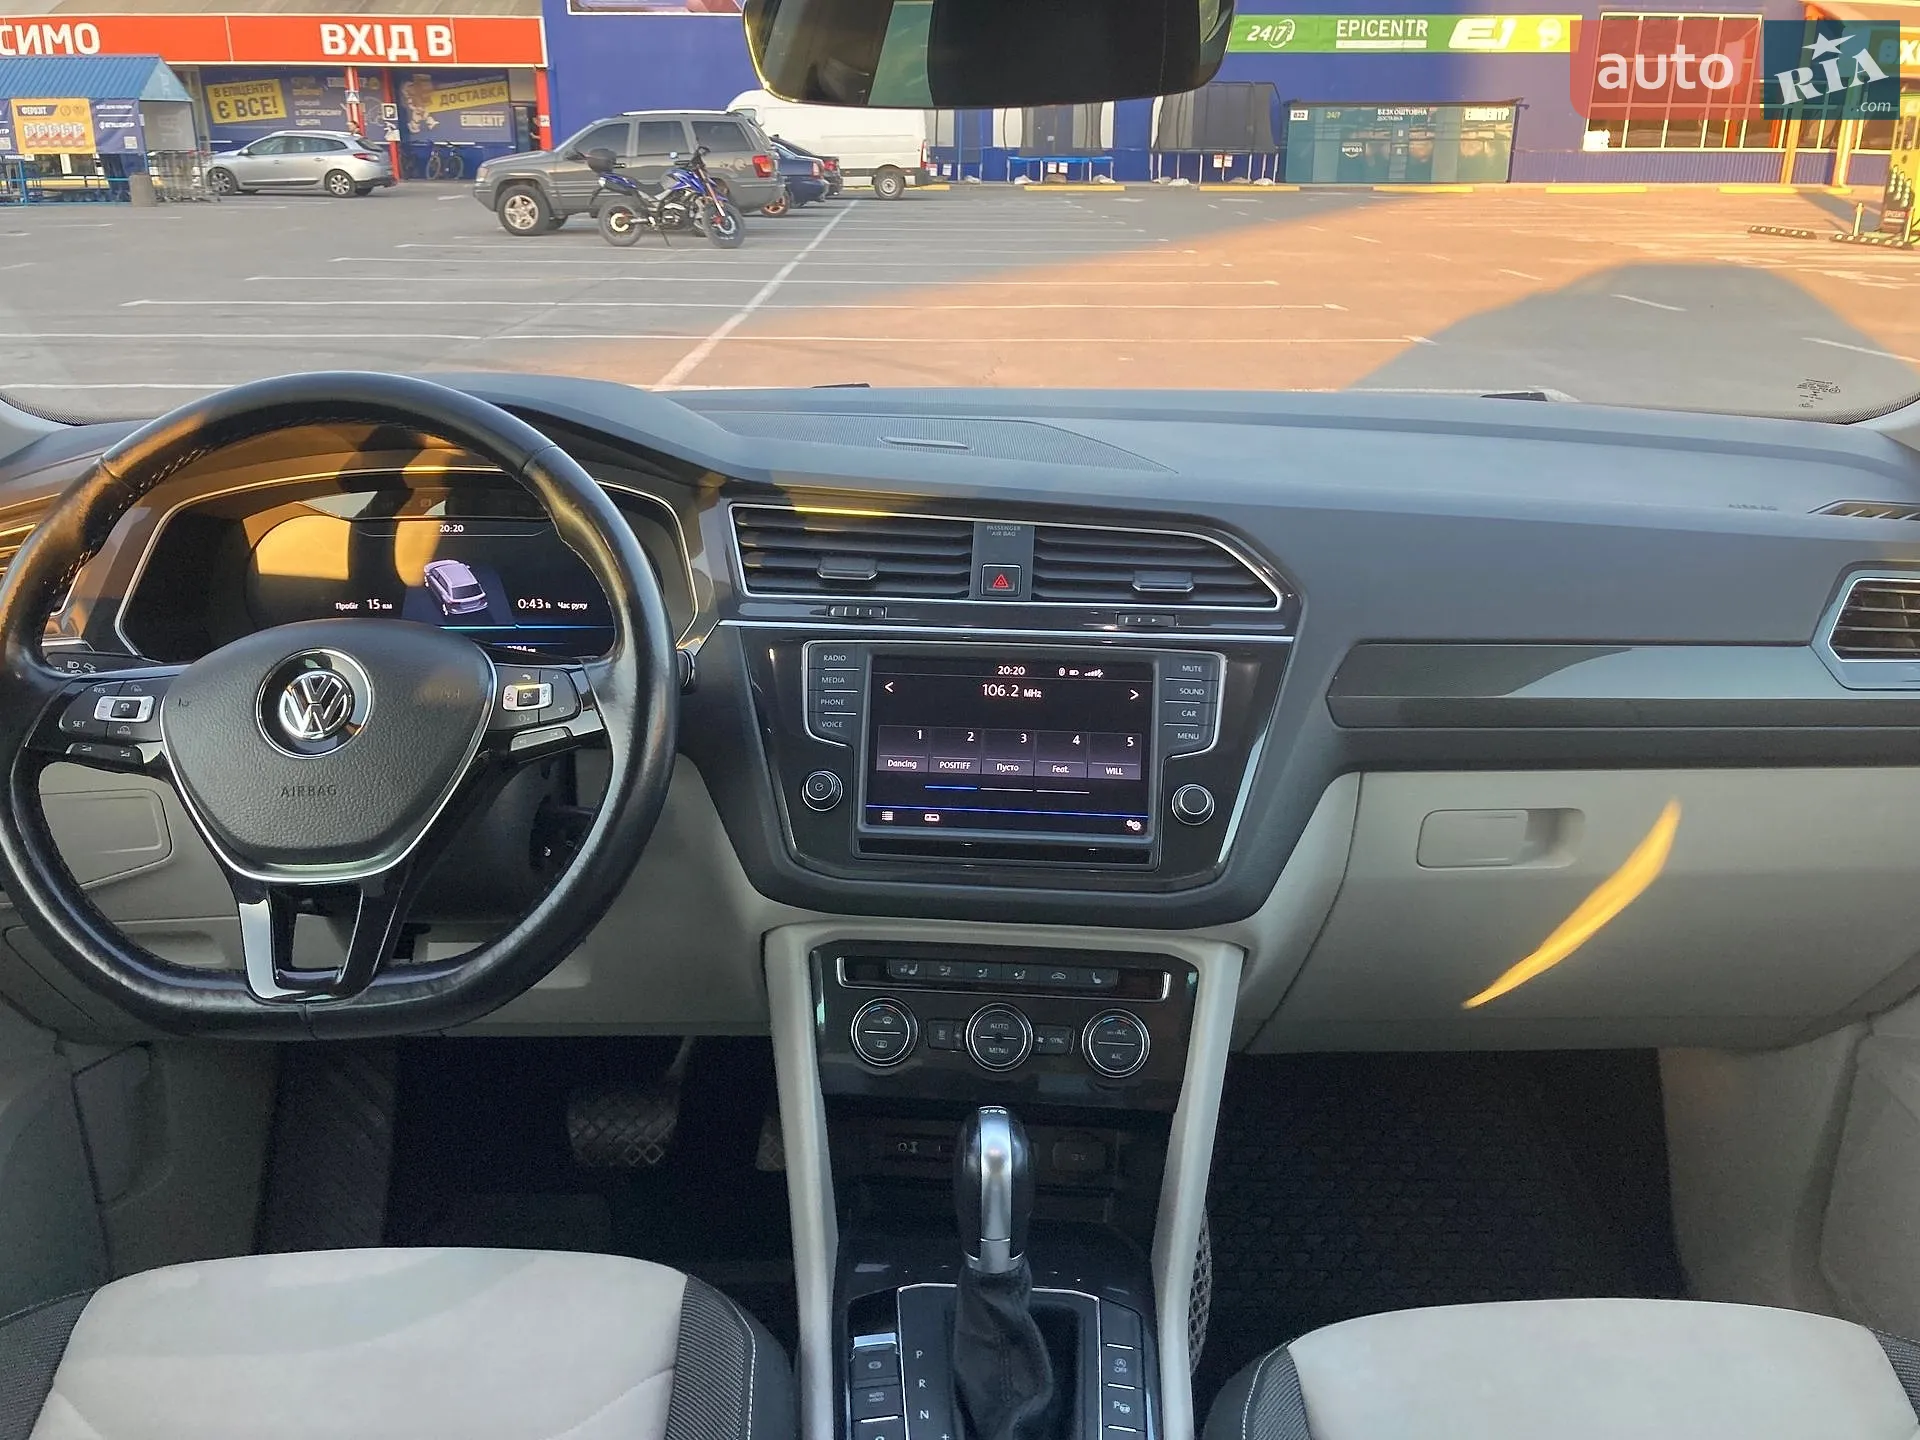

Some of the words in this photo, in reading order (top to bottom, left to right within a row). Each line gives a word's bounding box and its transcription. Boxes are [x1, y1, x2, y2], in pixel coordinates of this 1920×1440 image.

[1336, 18, 1429, 38] EPICENTR
[1247, 24, 1288, 43] 24/7
[319, 23, 419, 61] ВХІД
[426, 24, 453, 57] В
[440, 85, 506, 108] ДОСТАВКА
[217, 100, 231, 119] Є
[234, 95, 279, 118] ВСЕ!
[439, 524, 465, 533] 20:20
[366, 599, 380, 609] 15
[517, 599, 544, 609] 0:43
[997, 665, 1026, 676] 20:20
[1182, 665, 1203, 673] MUTE
[522, 691, 533, 699] OK
[982, 683, 1020, 698] 106.2
[1023, 688, 1042, 698] MHz
[1179, 688, 1205, 696] SOUND
[917, 730, 923, 740] 1
[967, 731, 975, 742] 2
[1020, 733, 1028, 743] 3
[1072, 735, 1081, 745] 4
[1177, 732, 1200, 740] MENU
[1127, 736, 1134, 747] 5
[887, 759, 917, 770] Dancing
[939, 760, 971, 770] POSITIFF
[996, 763, 1020, 774] Пусто
[1105, 767, 1123, 775] WILL
[280, 784, 337, 798] AIRBAG
[916, 1350, 924, 1359] P
[918, 1379, 928, 1388] R
[919, 1409, 930, 1420] N
